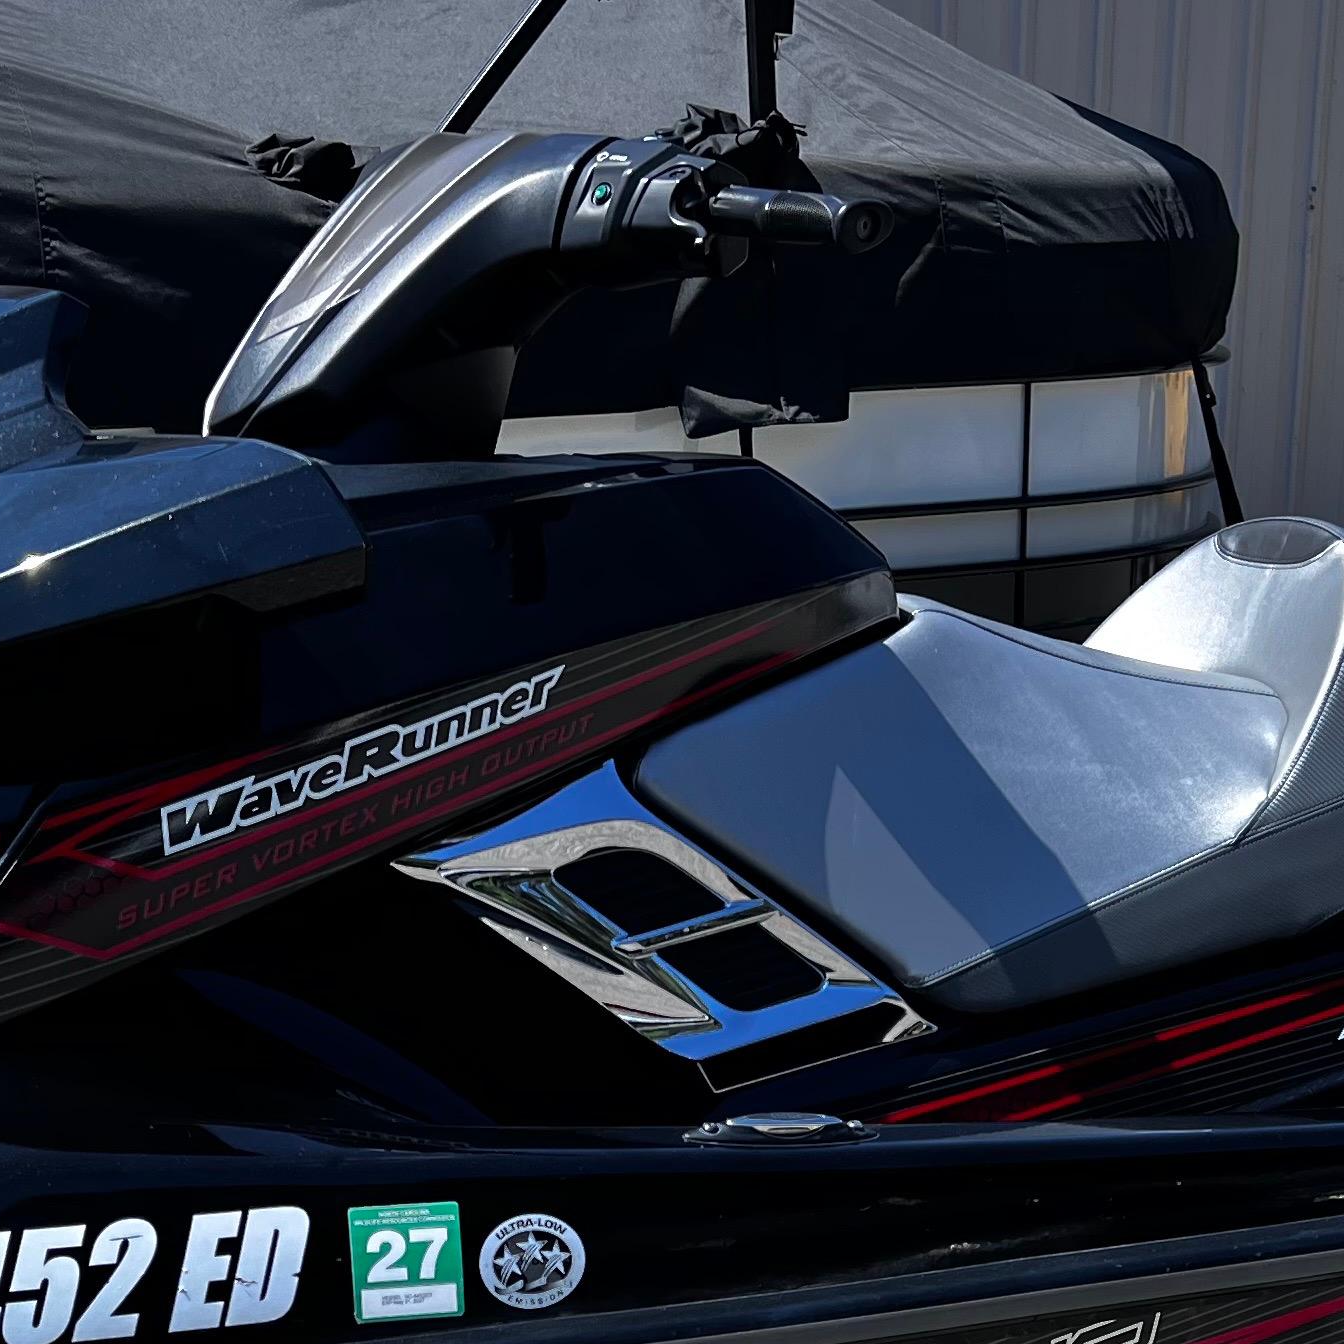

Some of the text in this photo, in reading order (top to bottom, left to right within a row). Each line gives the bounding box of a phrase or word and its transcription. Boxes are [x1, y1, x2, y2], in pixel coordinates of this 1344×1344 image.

[115, 712, 596, 930] SUPER VORTEX HIGH OUTPUT
[160, 664, 566, 856] WaveRunner
[167, 1206, 311, 1334] ED
[366, 1227, 449, 1284] 27
[493, 1216, 569, 1241] ULTRA-LOW
